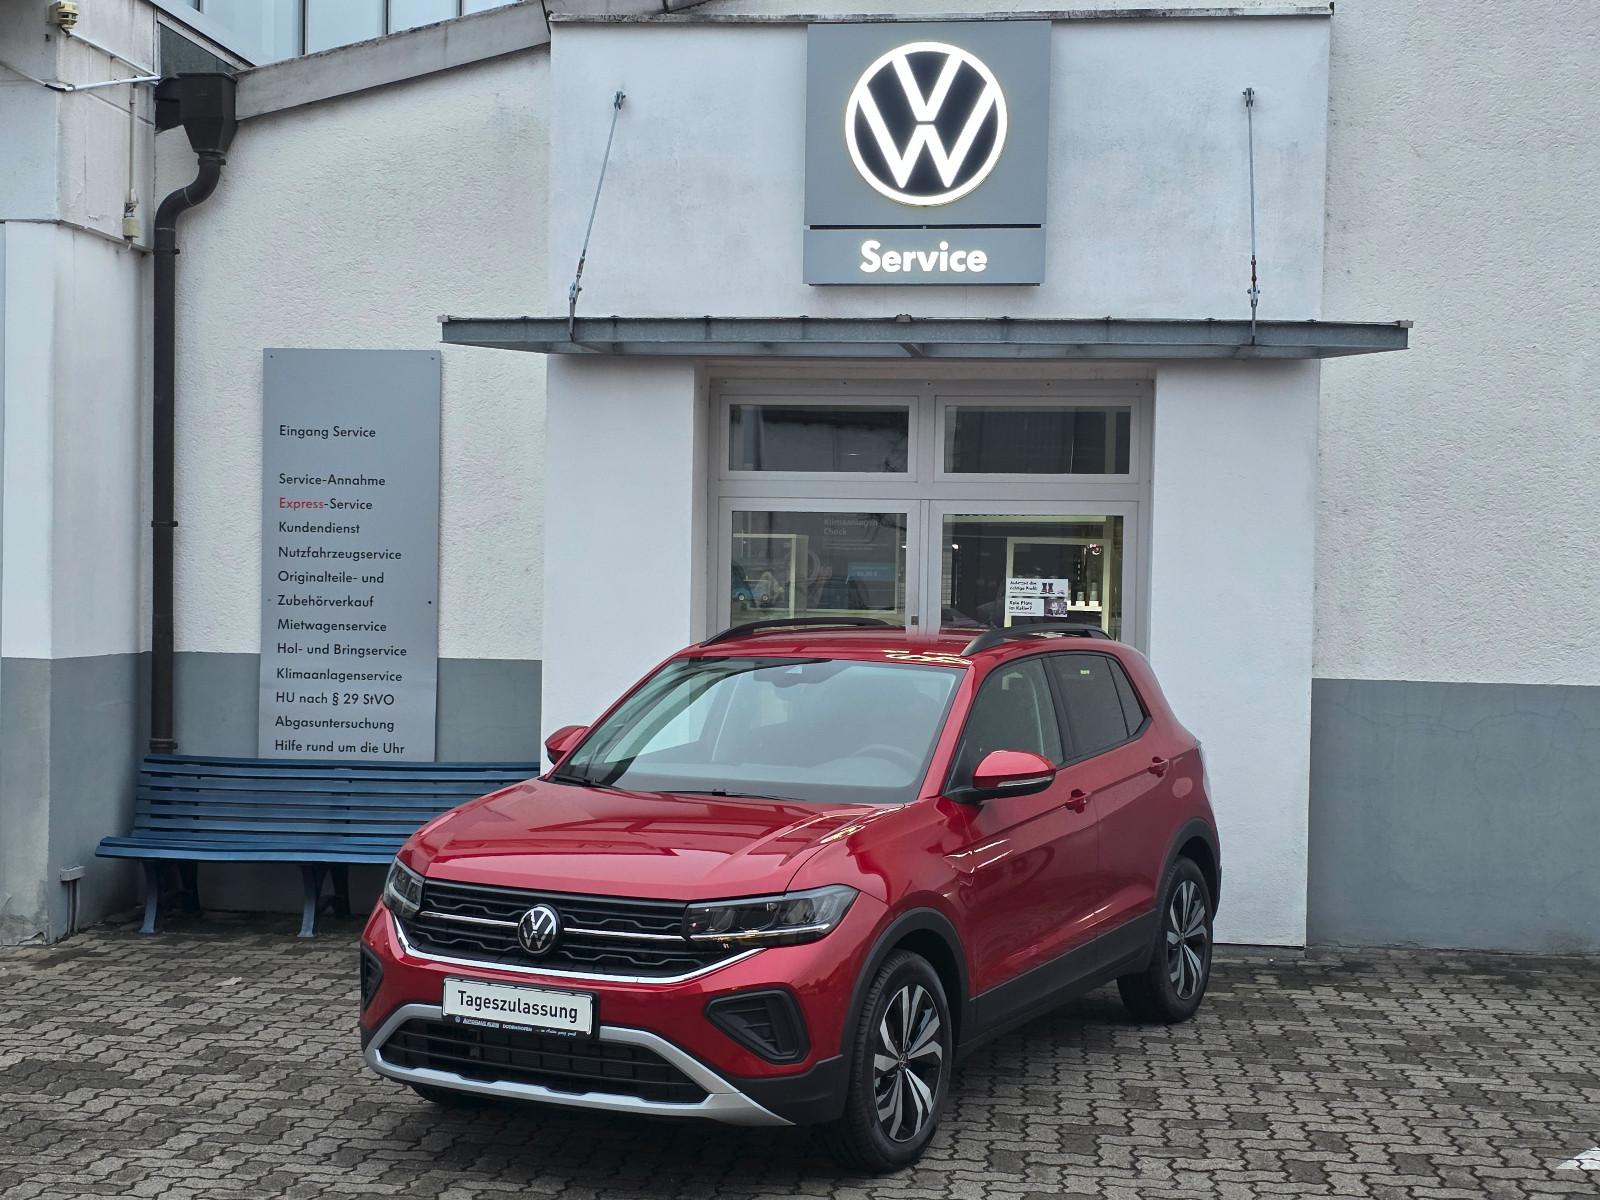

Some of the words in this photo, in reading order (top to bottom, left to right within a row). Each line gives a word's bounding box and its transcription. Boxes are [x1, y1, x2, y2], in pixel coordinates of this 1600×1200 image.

[859, 239, 988, 273] Service
[279, 425, 328, 439] Eingang
[333, 426, 376, 438] Service
[279, 473, 386, 486] Service-Annahme
[279, 498, 373, 511] Express-Service
[279, 522, 360, 534] Kundendienst
[279, 547, 402, 561] Nutzfahrzeugservice
[278, 571, 357, 584] Originalteile-
[362, 573, 384, 583] und
[277, 595, 374, 607] Zubehörverkauf
[277, 619, 387, 633] Mietwagenservice
[277, 643, 302, 654] Hol-
[307, 644, 329, 655] und
[334, 644, 407, 658] Bringservice
[277, 668, 402, 683] Klimaanlagenservice
[276, 692, 295, 703] HU
[300, 692, 328, 704] nach
[332, 692, 339, 706] §
[343, 694, 358, 705] 29
[363, 694, 395, 705] StVO
[275, 716, 394, 732] Abgasuntersuchung
[275, 740, 302, 752] Hilfe
[307, 741, 333, 752] rund
[338, 744, 356, 753] um
[360, 742, 379, 754] die
[383, 743, 405, 754] Uhr
[458, 990, 578, 1023] Tageszulassung
